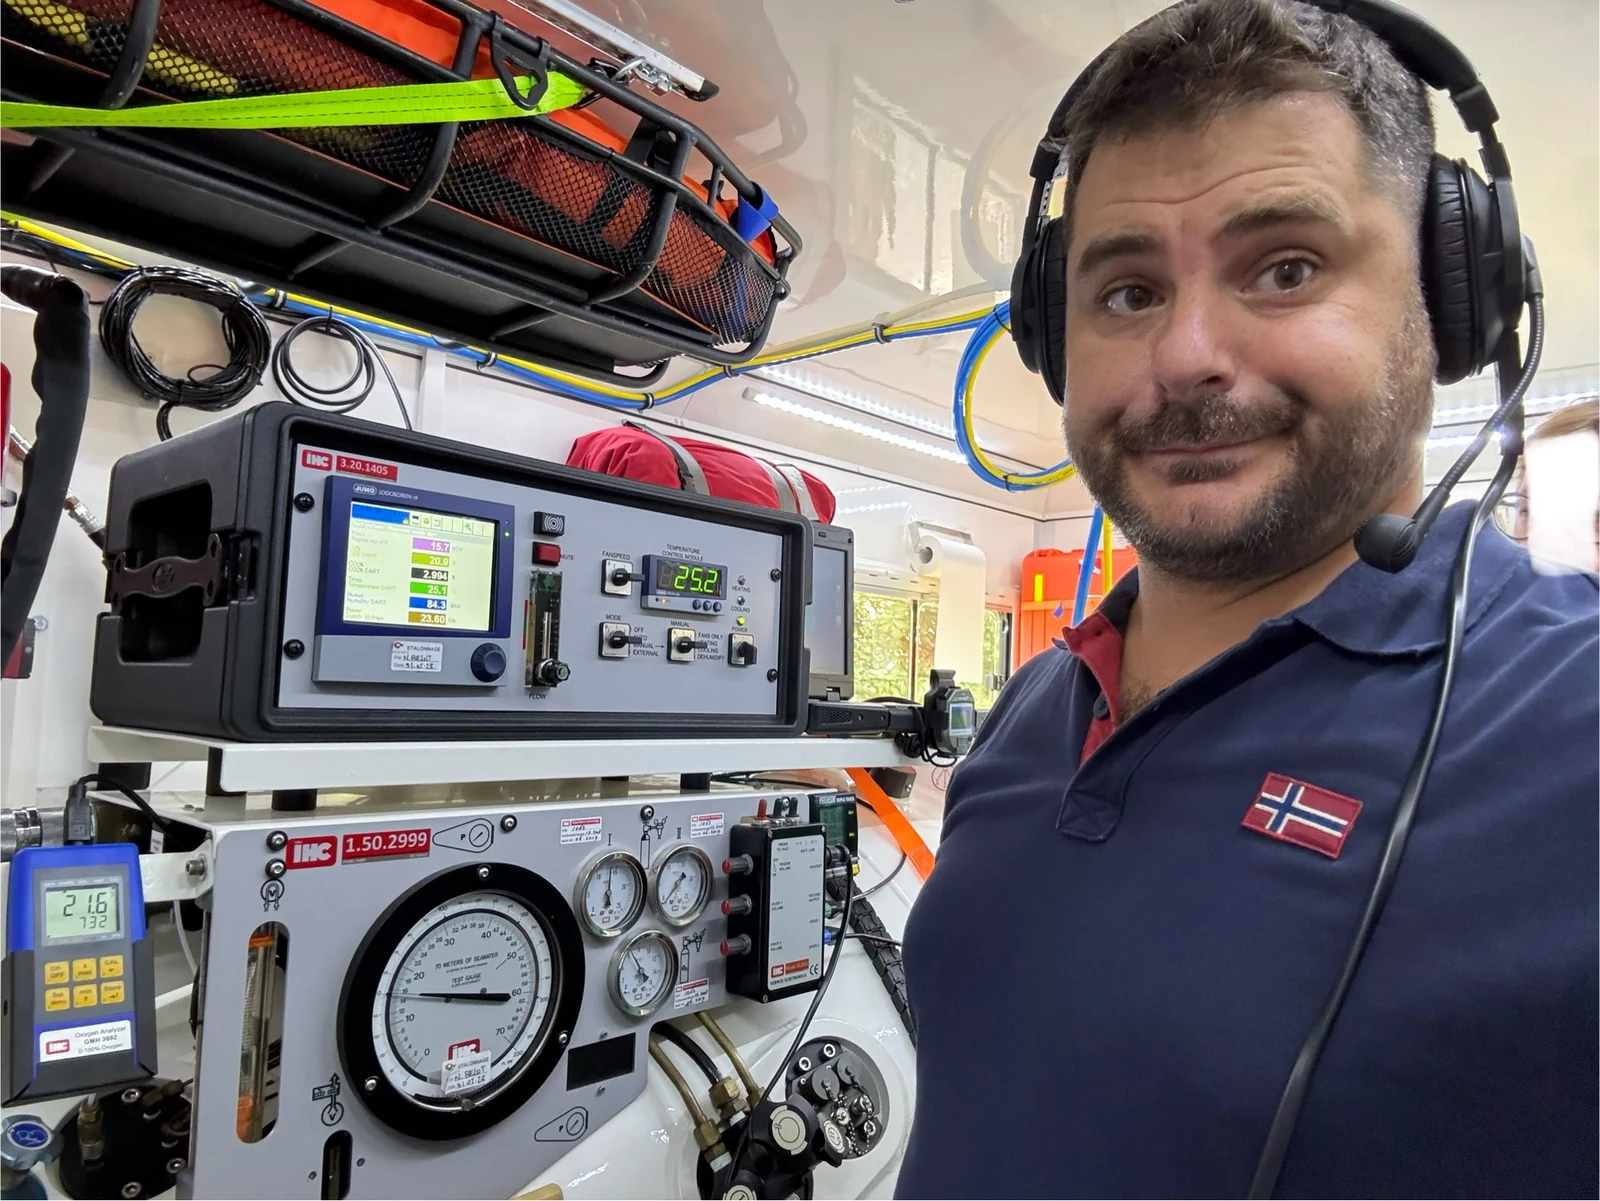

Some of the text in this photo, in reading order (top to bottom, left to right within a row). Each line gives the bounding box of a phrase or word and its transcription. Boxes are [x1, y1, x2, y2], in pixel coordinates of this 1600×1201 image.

[306, 452, 388, 476] IHC 3.20.1405
[355, 485, 376, 494] JUMO
[431, 542, 449, 551] 15.7
[667, 544, 700, 554] TEMPERATURE
[602, 551, 631, 560] FANSPEED
[662, 550, 684, 559] CONTROL
[430, 556, 449, 565] 20.9
[423, 570, 447, 580] 2.994
[674, 565, 718, 593] 25.2
[427, 585, 447, 594] 25.1
[427, 600, 446, 609] 84.3
[421, 614, 445, 624] 23.60
[293, 841, 332, 863] IHC
[345, 831, 427, 853] 1.50.2999
[63, 892, 107, 917] 21.6
[80, 915, 107, 929] 732
[444, 938, 455, 947] 30
[507, 951, 516, 959] 50
[435, 962, 442, 970] 70
[443, 959, 463, 968] METERS
[474, 952, 498, 962] SEAWATER
[414, 971, 424, 980] 20
[465, 972, 481, 980] GAUGE
[512, 988, 522, 996] 60
[405, 1013, 414, 1022] 10
[74, 1026, 126, 1038] Oxygen Analyzer
[495, 1027, 505, 1036] 70
[49, 1042, 68, 1052] IHC
[101, 1043, 123, 1051] Oxygen
[424, 1048, 430, 1056] 0
[458, 1057, 489, 1069] ETALONNAGE
